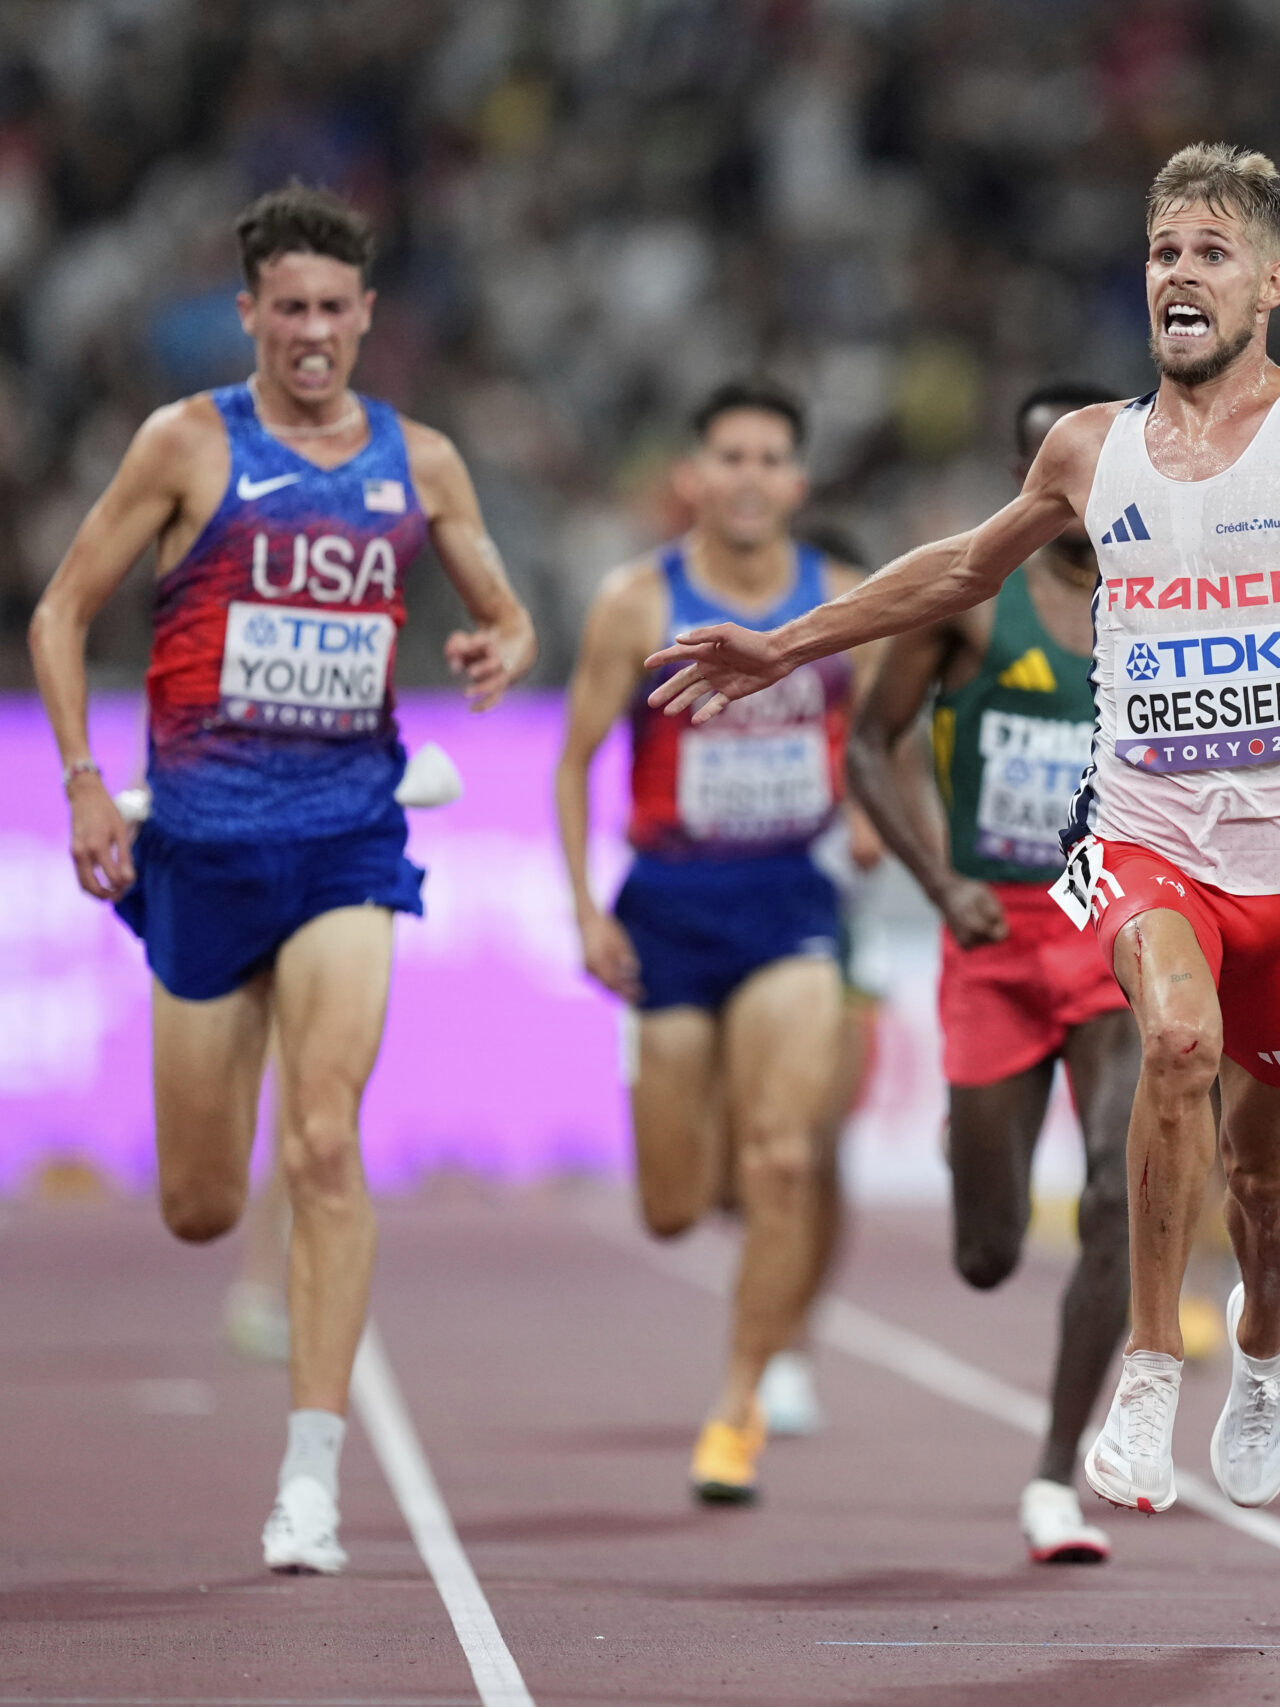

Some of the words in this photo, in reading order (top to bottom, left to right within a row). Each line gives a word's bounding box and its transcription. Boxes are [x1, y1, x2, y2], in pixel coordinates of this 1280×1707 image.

[1215, 521, 1249, 534] Crédit
[253, 533, 397, 606] USA
[282, 617, 381, 655] TDK
[239, 658, 377, 701] YOUNG
